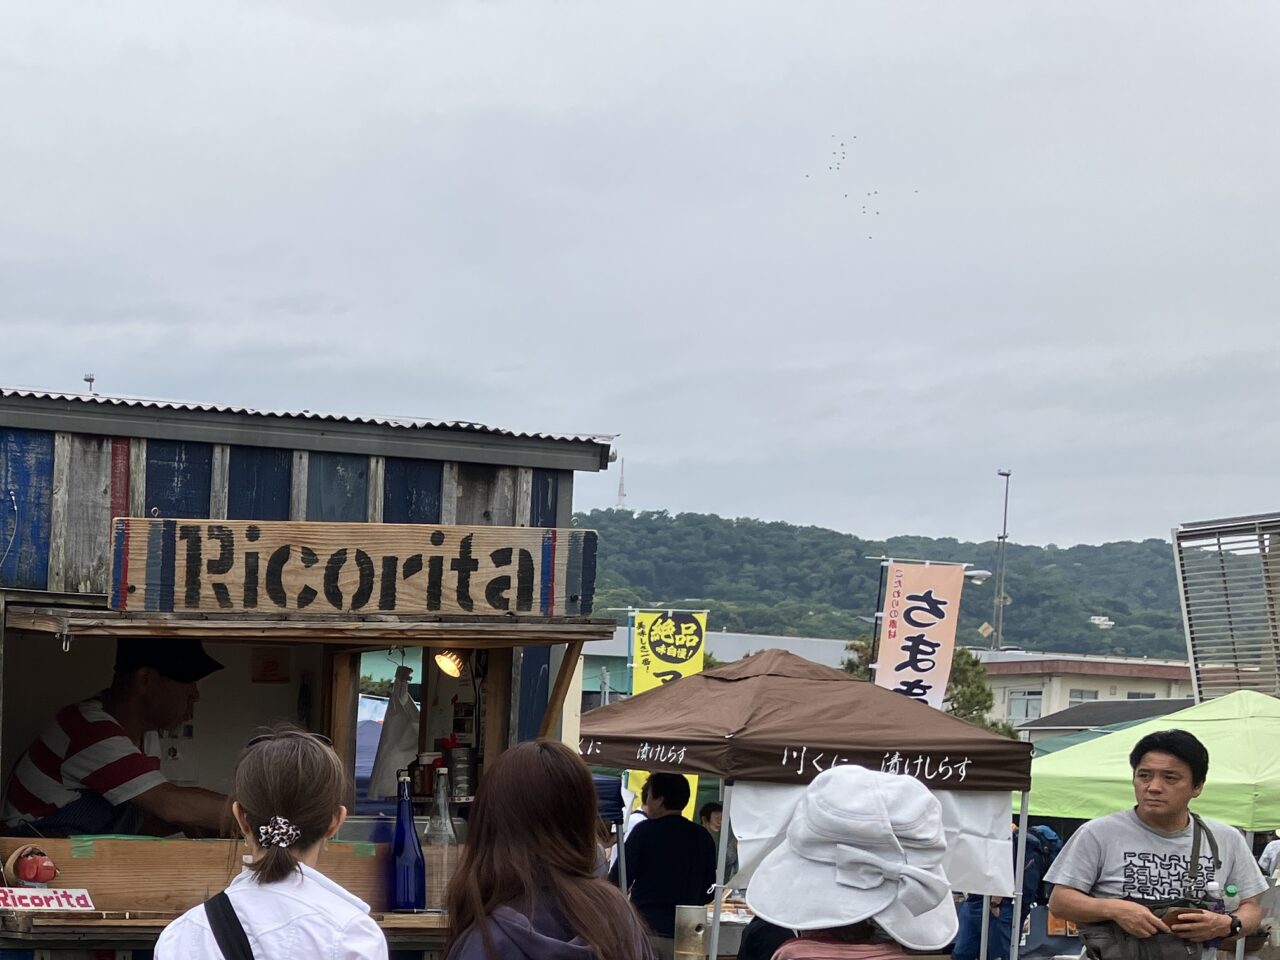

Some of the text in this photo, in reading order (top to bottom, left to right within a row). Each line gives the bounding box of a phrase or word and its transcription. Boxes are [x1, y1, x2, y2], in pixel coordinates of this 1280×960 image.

[178, 524, 535, 612] Ricorita
[650, 618, 699, 648] 絶品
[637, 742, 687, 764] 漬けしらす
[880, 751, 973, 782] 漬けしらす
[1123, 851, 1215, 864] PENALY
